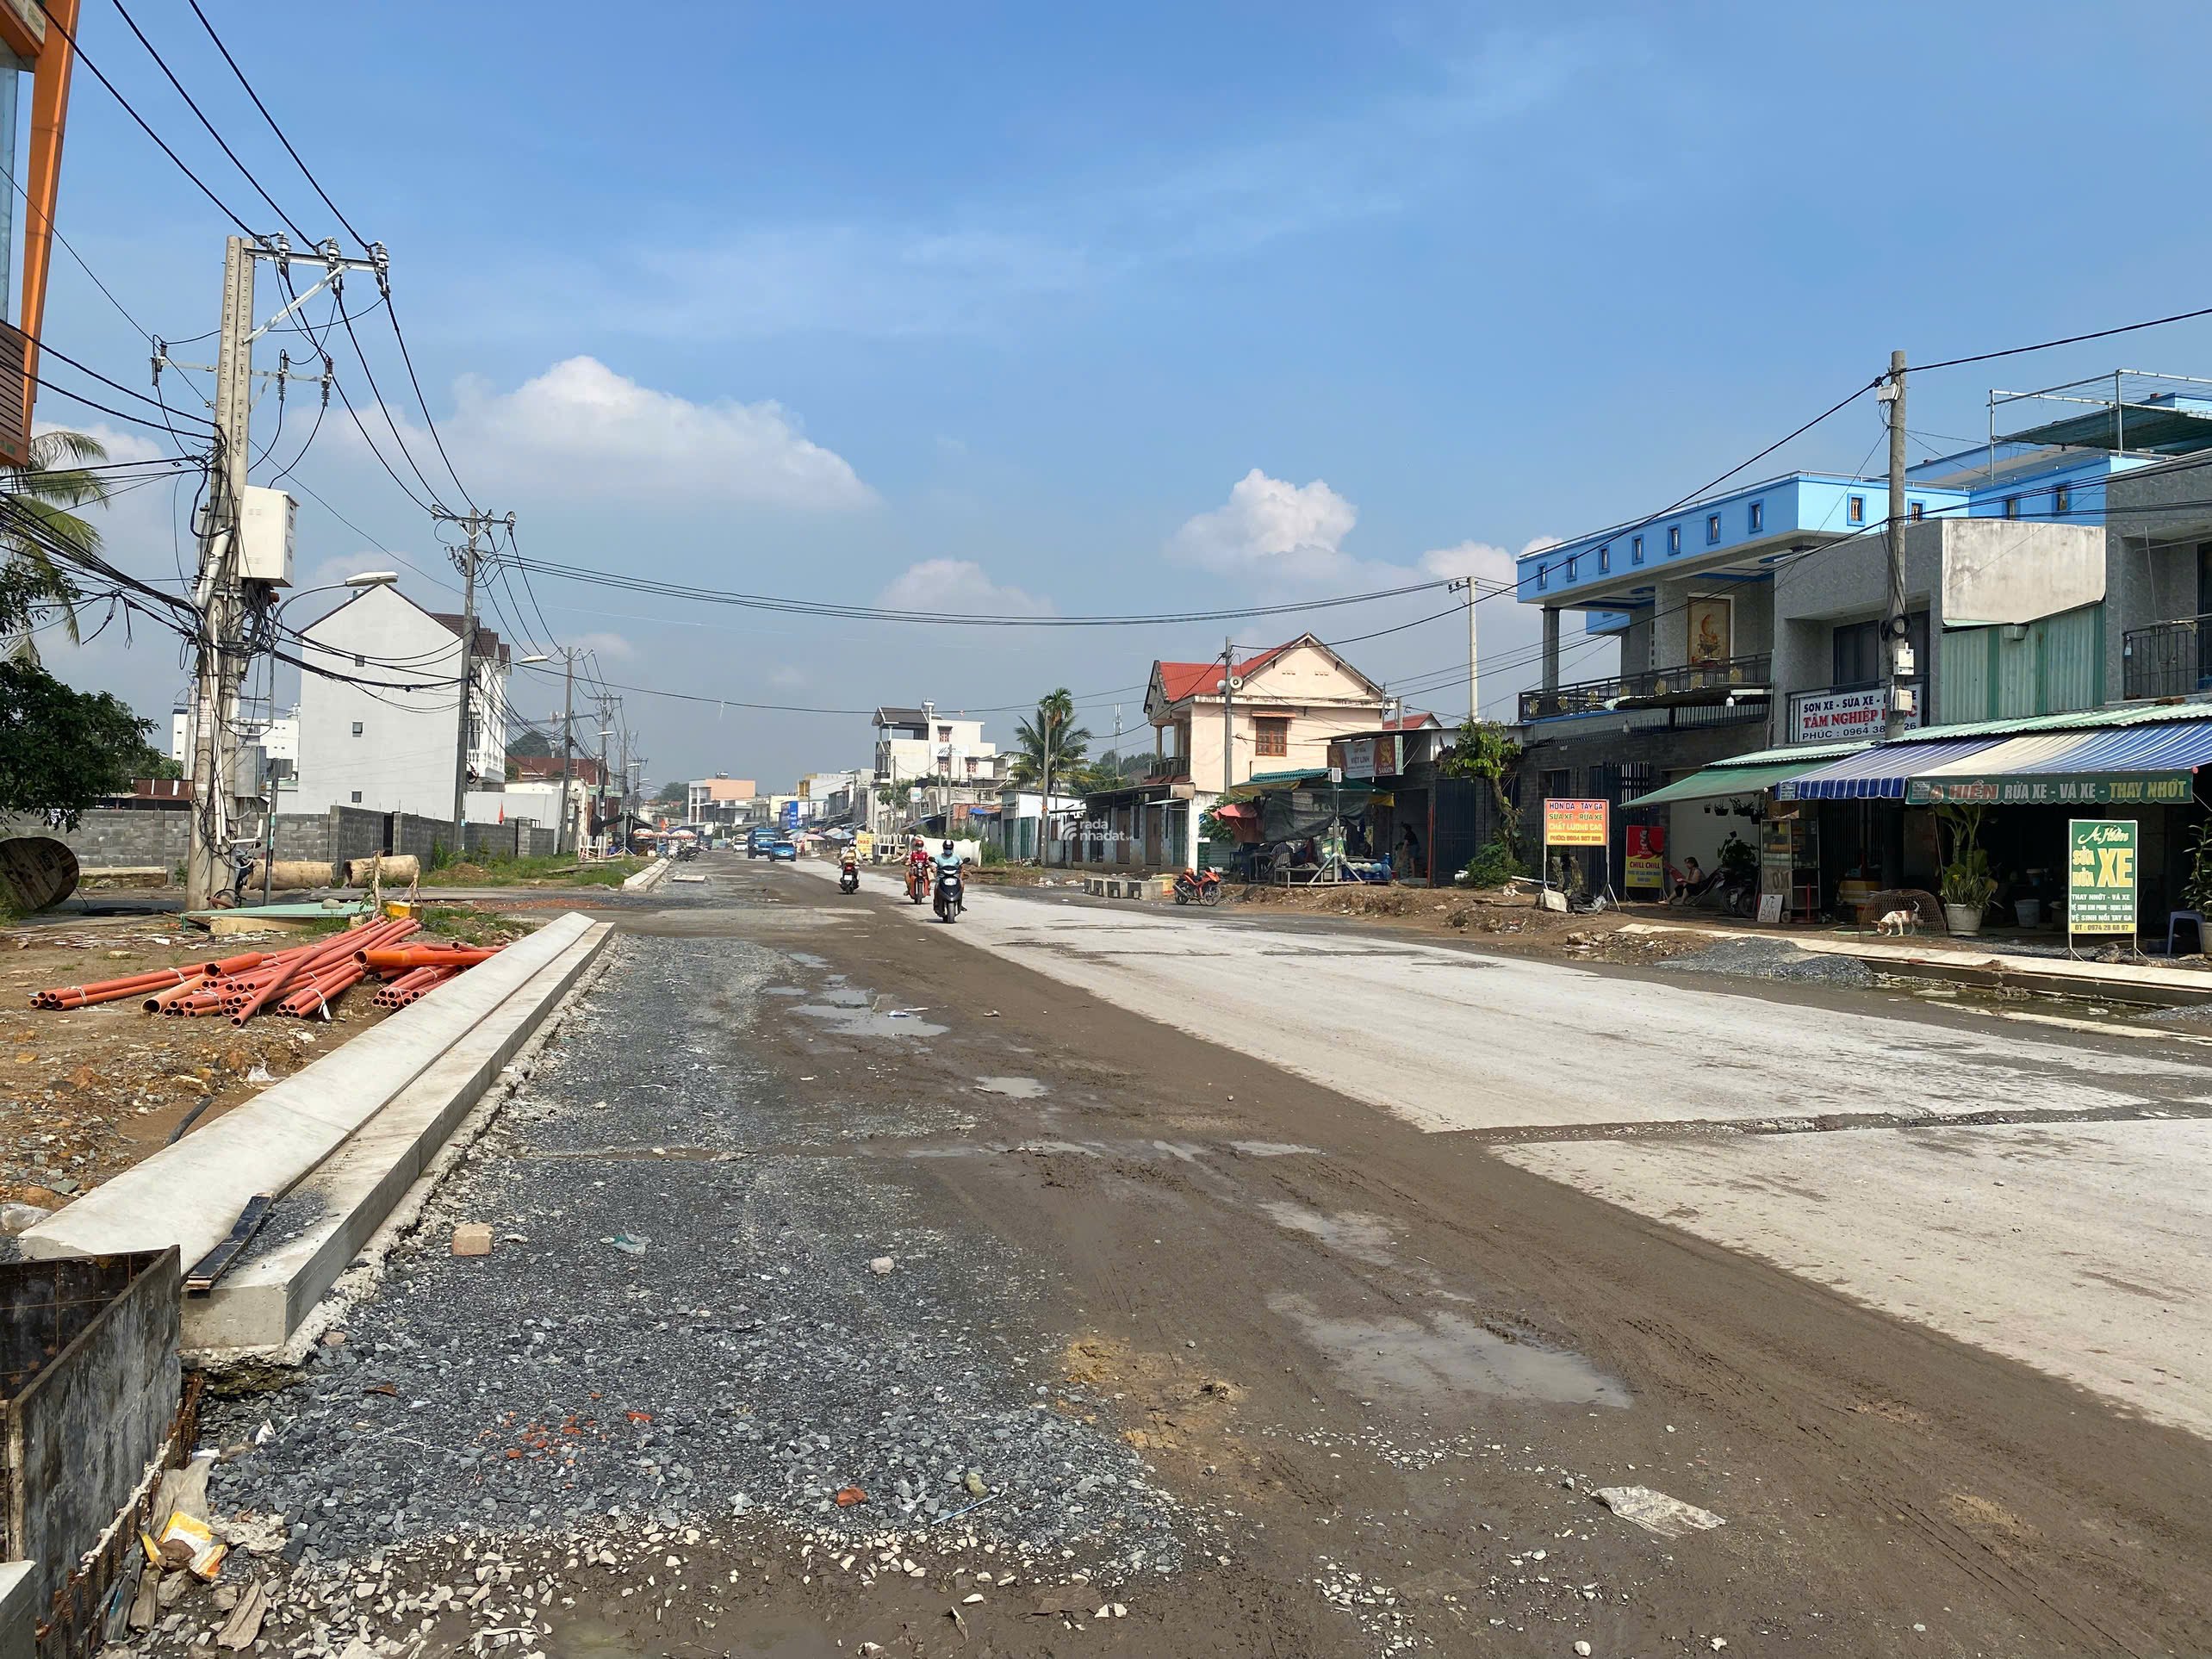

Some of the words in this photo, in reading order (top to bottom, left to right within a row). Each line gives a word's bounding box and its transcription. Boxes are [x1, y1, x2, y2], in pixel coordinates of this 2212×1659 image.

[1824, 700, 1834, 711] XE
[1862, 695, 1874, 706] XE
[1804, 713, 1830, 729] TÂM
[1831, 707, 1879, 725] NGHIỆP
[1802, 729, 1833, 740] PHÚC
[1842, 727, 1869, 736] 0964
[1929, 785, 1944, 799] A
[2004, 780, 2029, 799] RỬA
[2032, 783, 2047, 799] XE
[2060, 780, 2077, 798] VÁ
[2080, 782, 2096, 799] XE
[2109, 781, 2143, 798] THAY
[2147, 778, 2187, 798] NHỚT
[2097, 848, 2134, 888] XE
